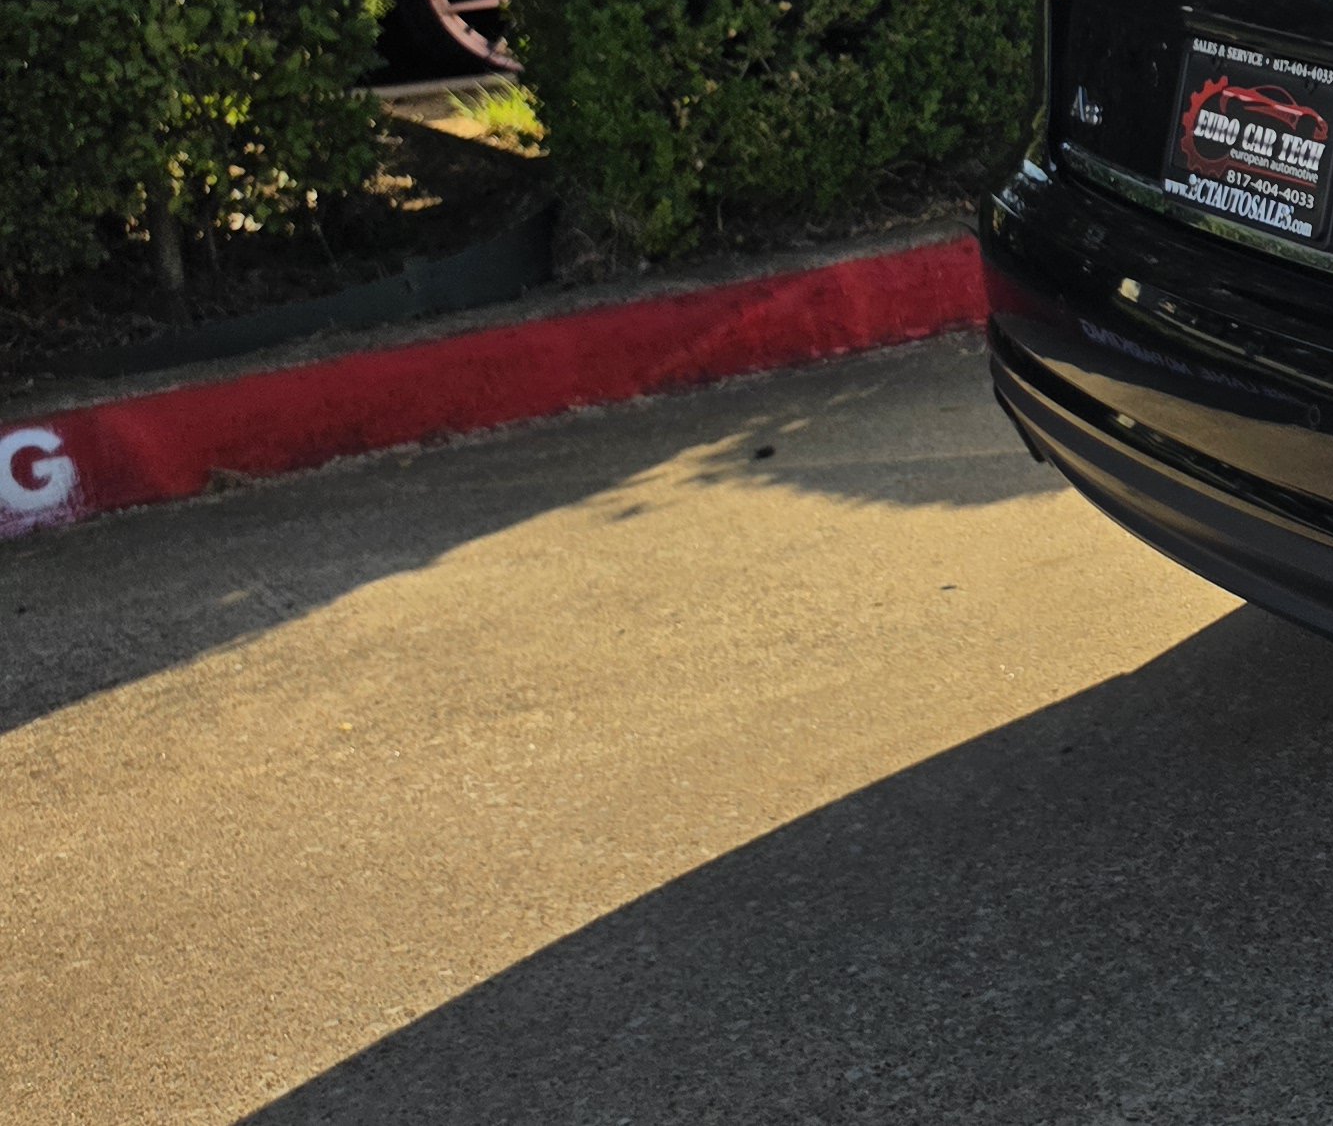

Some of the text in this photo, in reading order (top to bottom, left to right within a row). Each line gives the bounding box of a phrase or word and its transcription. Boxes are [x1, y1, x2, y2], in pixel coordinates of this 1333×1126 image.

[1193, 38, 1218, 56] SALES
[1227, 46, 1264, 67] SERVICE
[1273, 59, 1333, 85] 817-404-4033
[1194, 109, 1326, 171] EURO CAR TECH
[1230, 148, 1319, 184] european automotive
[1226, 170, 1315, 209] 817-404-4033
